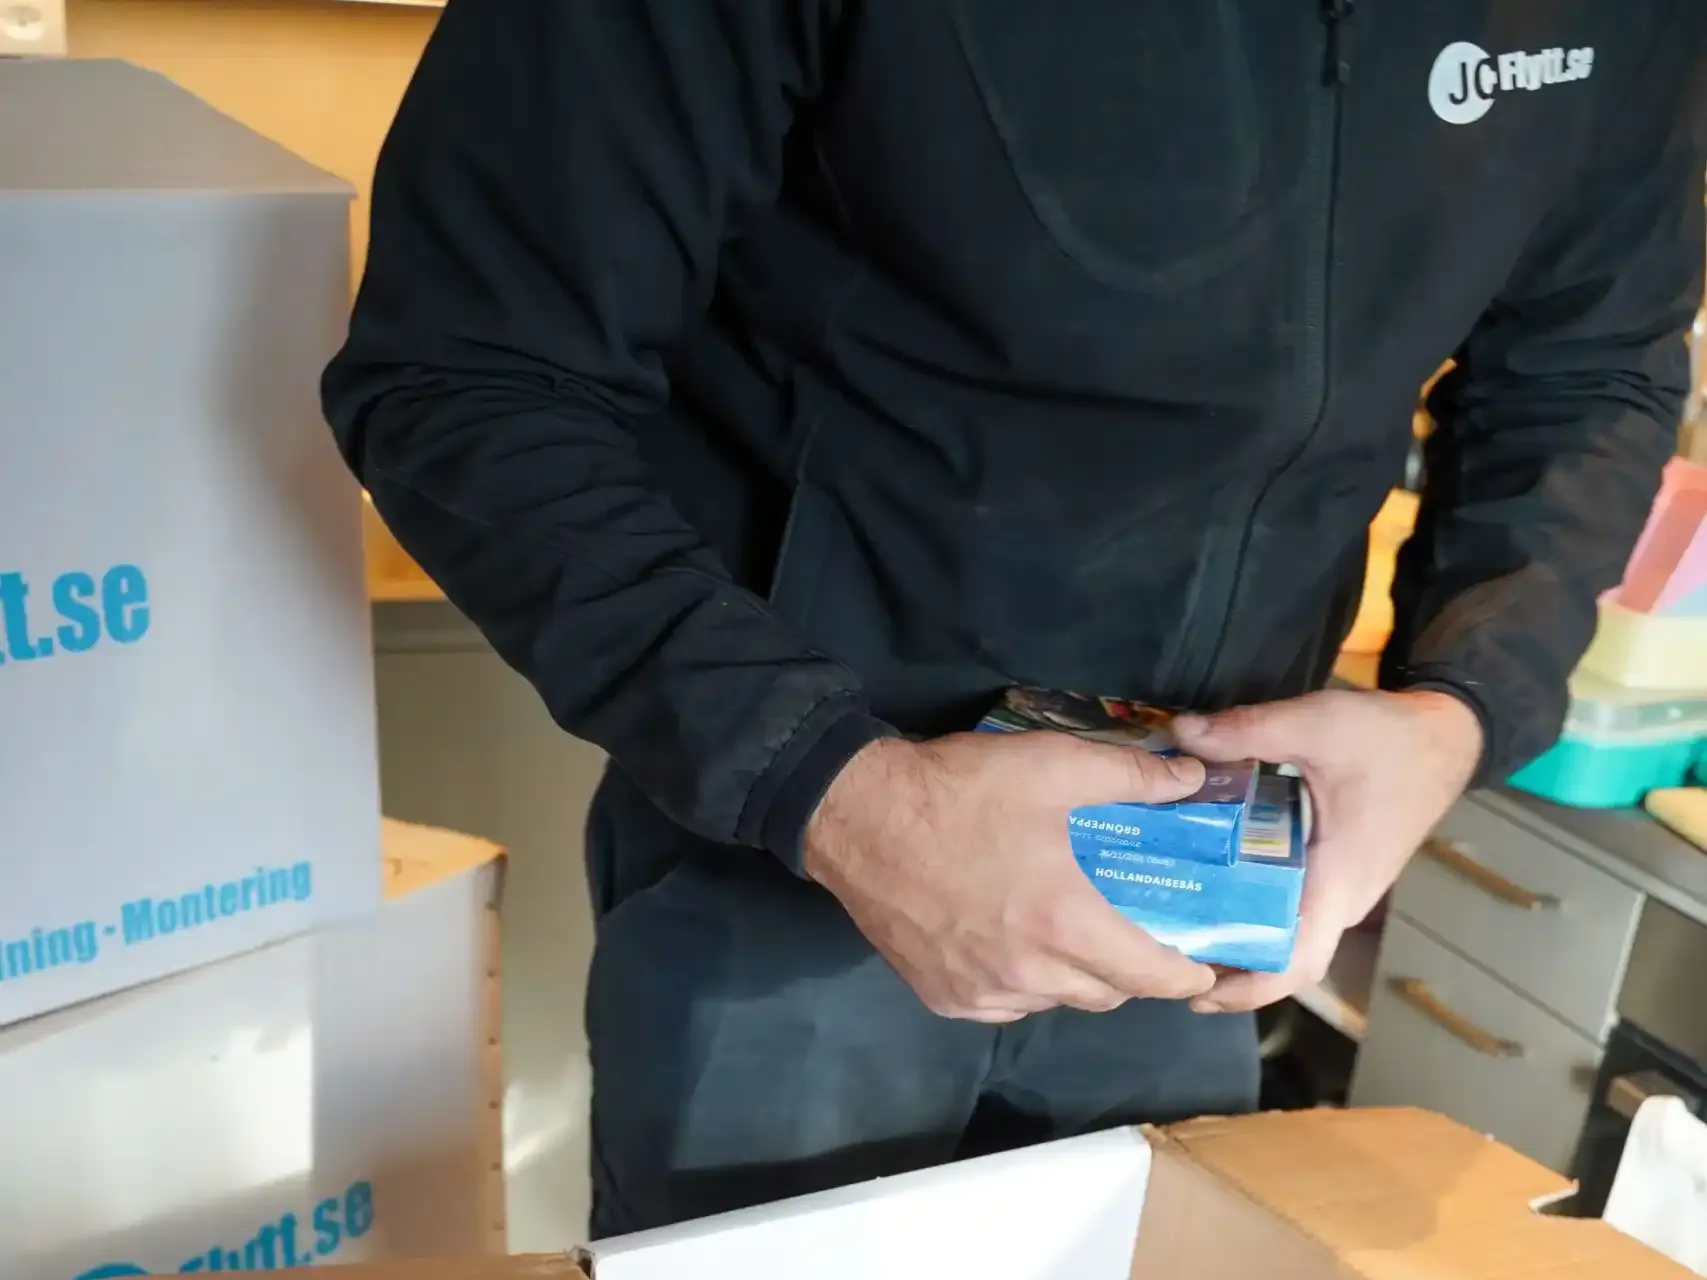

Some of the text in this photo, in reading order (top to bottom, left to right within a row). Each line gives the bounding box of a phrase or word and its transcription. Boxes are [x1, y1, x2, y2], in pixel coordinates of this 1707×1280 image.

[0, 564, 150, 665] t.se
[0, 920, 98, 982] ning
[121, 861, 312, 945] Montering
[1095, 867, 1203, 892] HOLLANDAISESÅS
